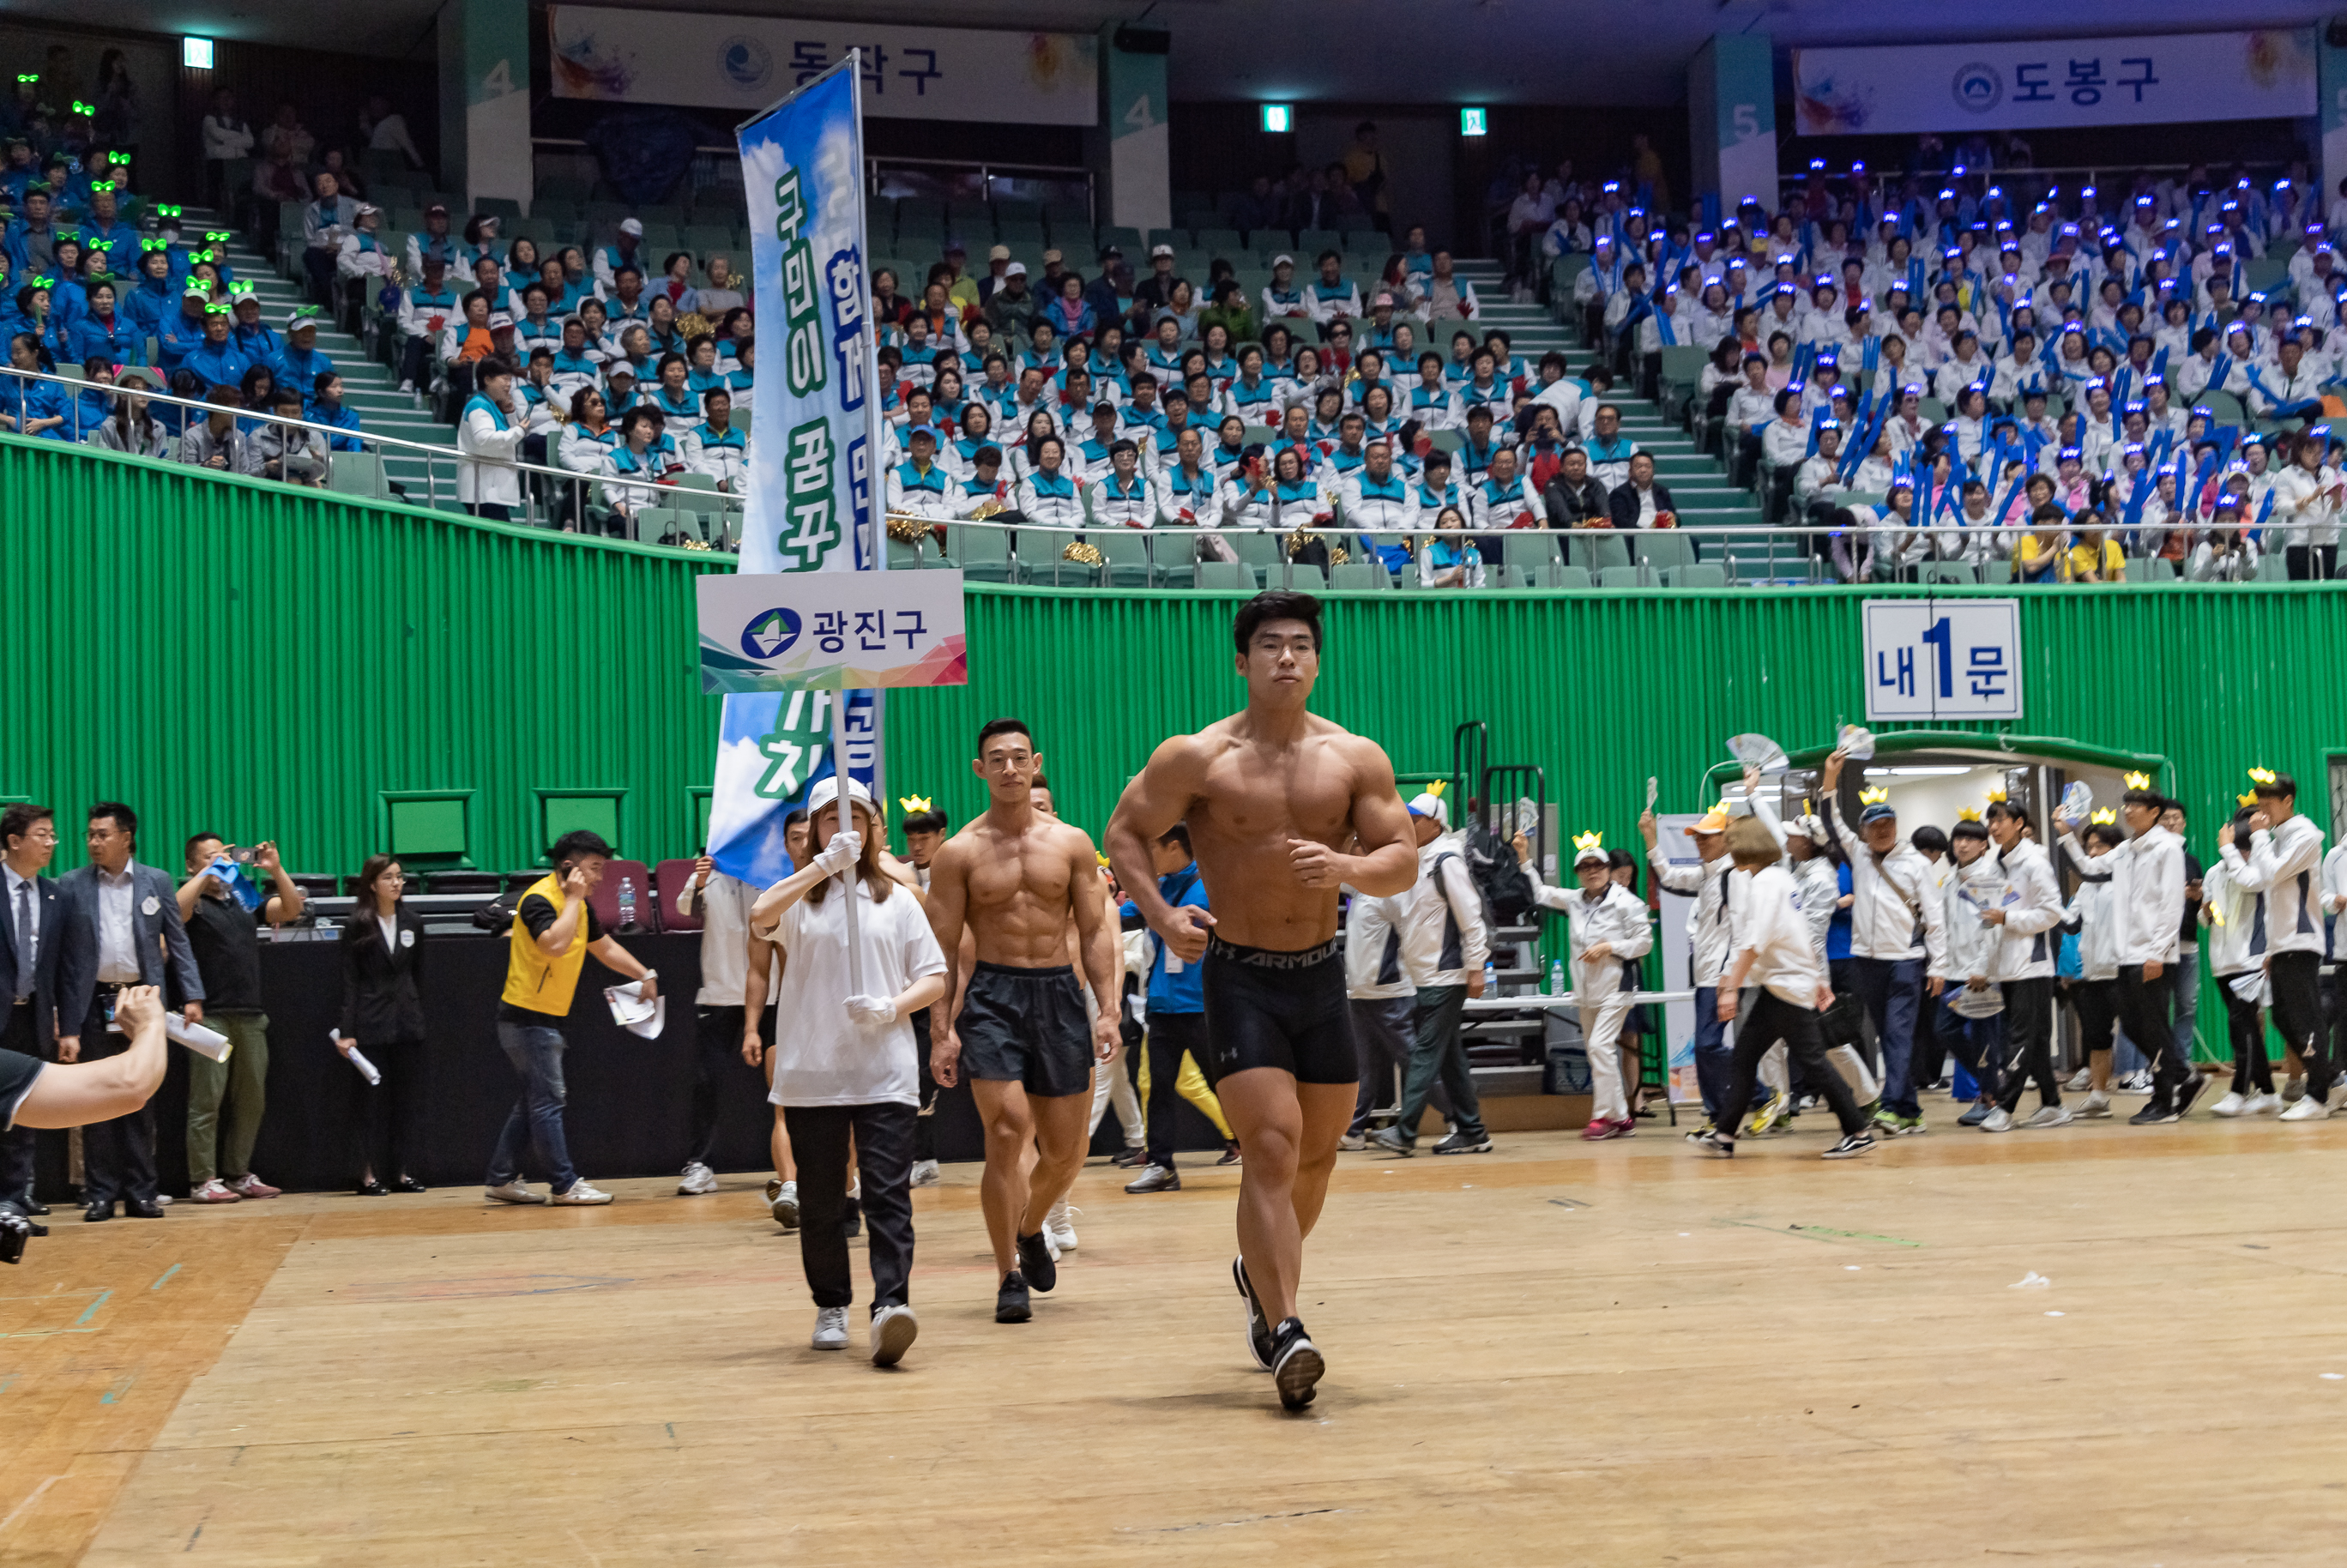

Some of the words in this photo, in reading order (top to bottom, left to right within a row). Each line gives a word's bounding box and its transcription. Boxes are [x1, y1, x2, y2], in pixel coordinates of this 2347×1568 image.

[482, 59, 515, 95] 4
[2012, 57, 2159, 106] 도봉구
[1125, 94, 1154, 130] 4
[1733, 104, 1759, 139] 5
[777, 168, 825, 395] 구민이
[812, 609, 927, 654] 광진구
